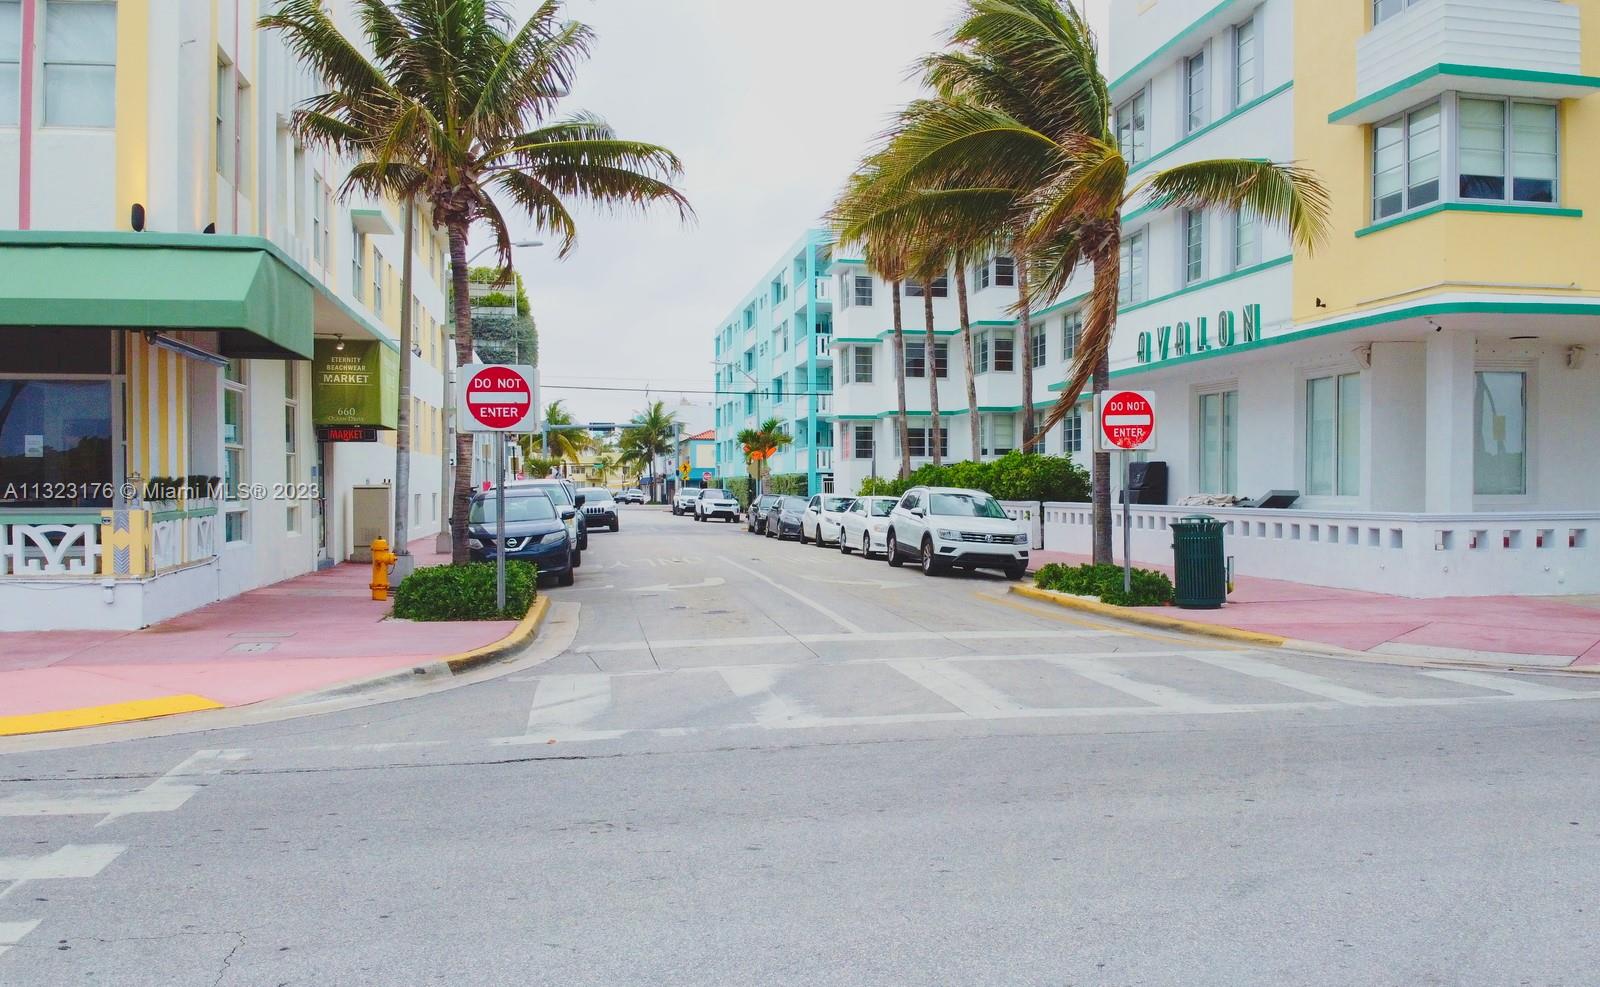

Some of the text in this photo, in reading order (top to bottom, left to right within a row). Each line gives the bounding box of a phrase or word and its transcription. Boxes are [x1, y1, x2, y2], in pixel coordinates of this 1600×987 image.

[1137, 304, 1260, 363] AVALON
[323, 374, 369, 383] MARKET
[474, 378, 522, 389] DO NOT
[1110, 401, 1146, 411] DO NOT
[337, 407, 356, 416] 660
[480, 407, 518, 418] ENTER
[329, 430, 364, 439] MARKET
[1113, 427, 1144, 437] ENTER
